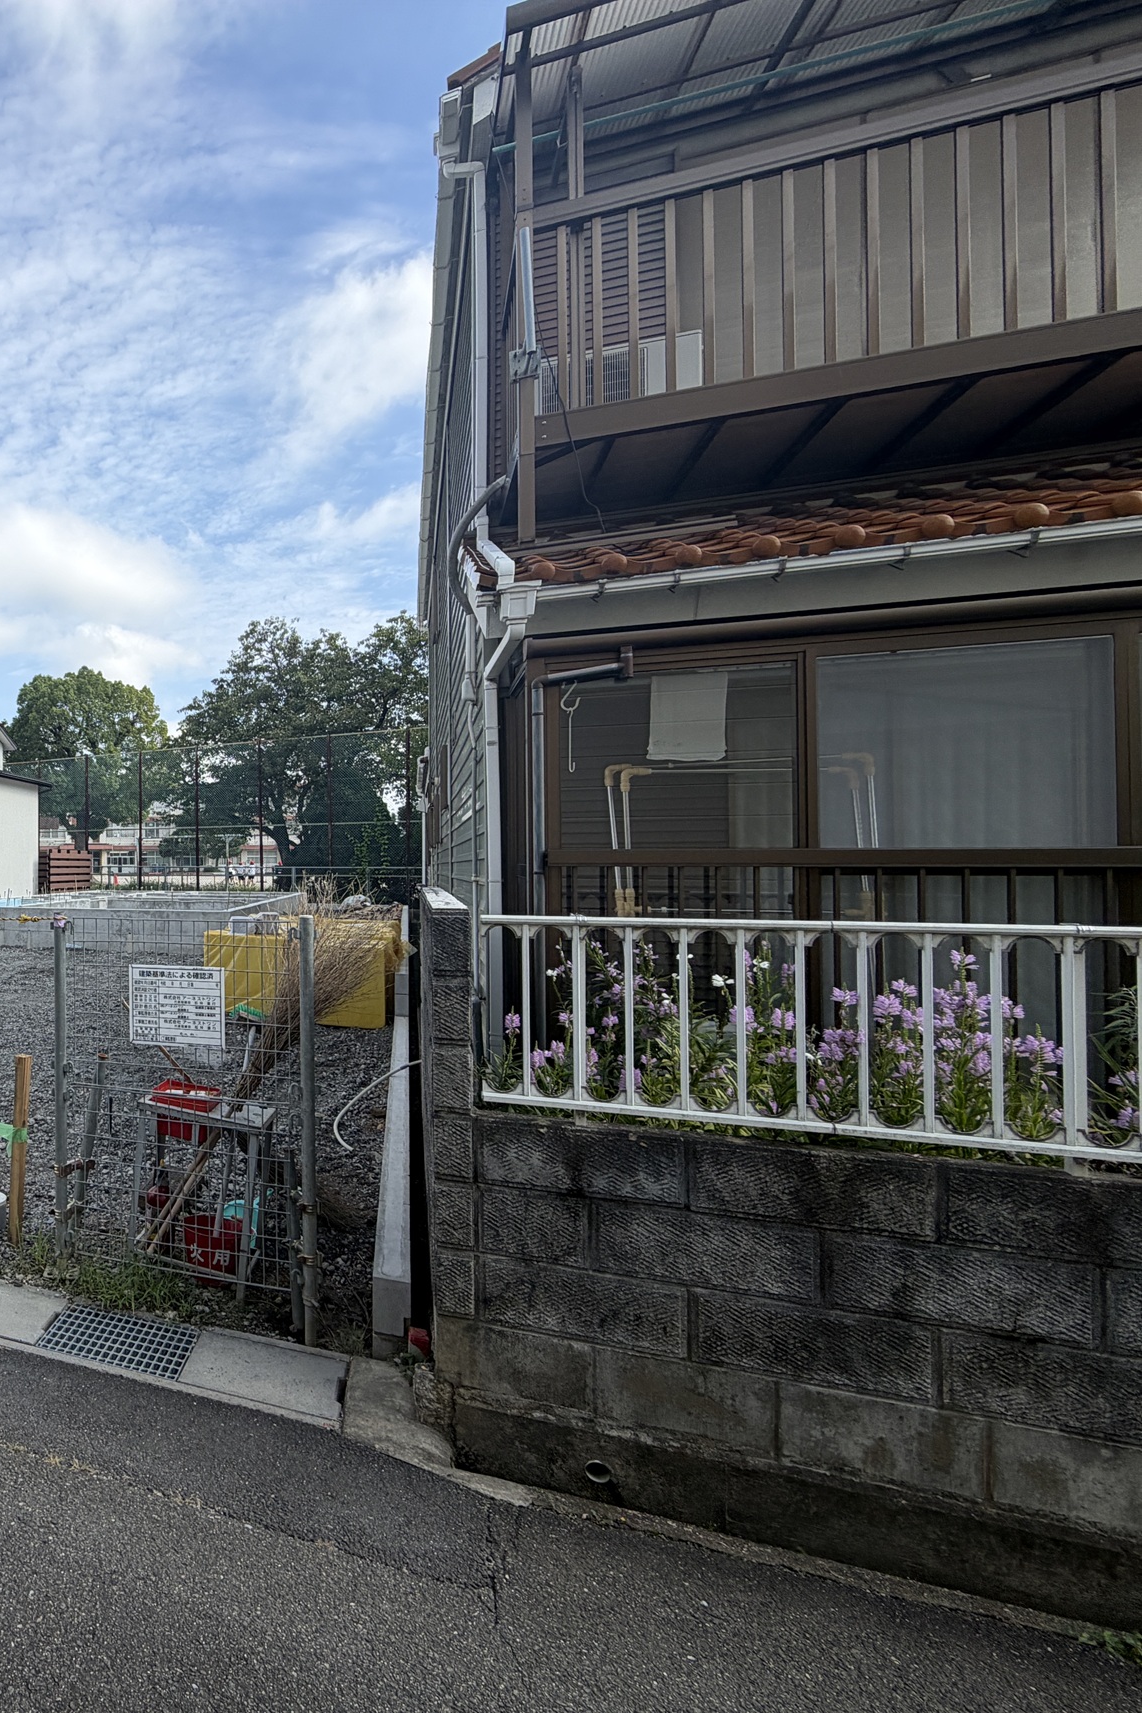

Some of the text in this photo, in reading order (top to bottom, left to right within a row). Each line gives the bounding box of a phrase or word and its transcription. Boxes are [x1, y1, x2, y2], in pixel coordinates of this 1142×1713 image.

[138, 970, 214, 980] 建築基準法による確認済
